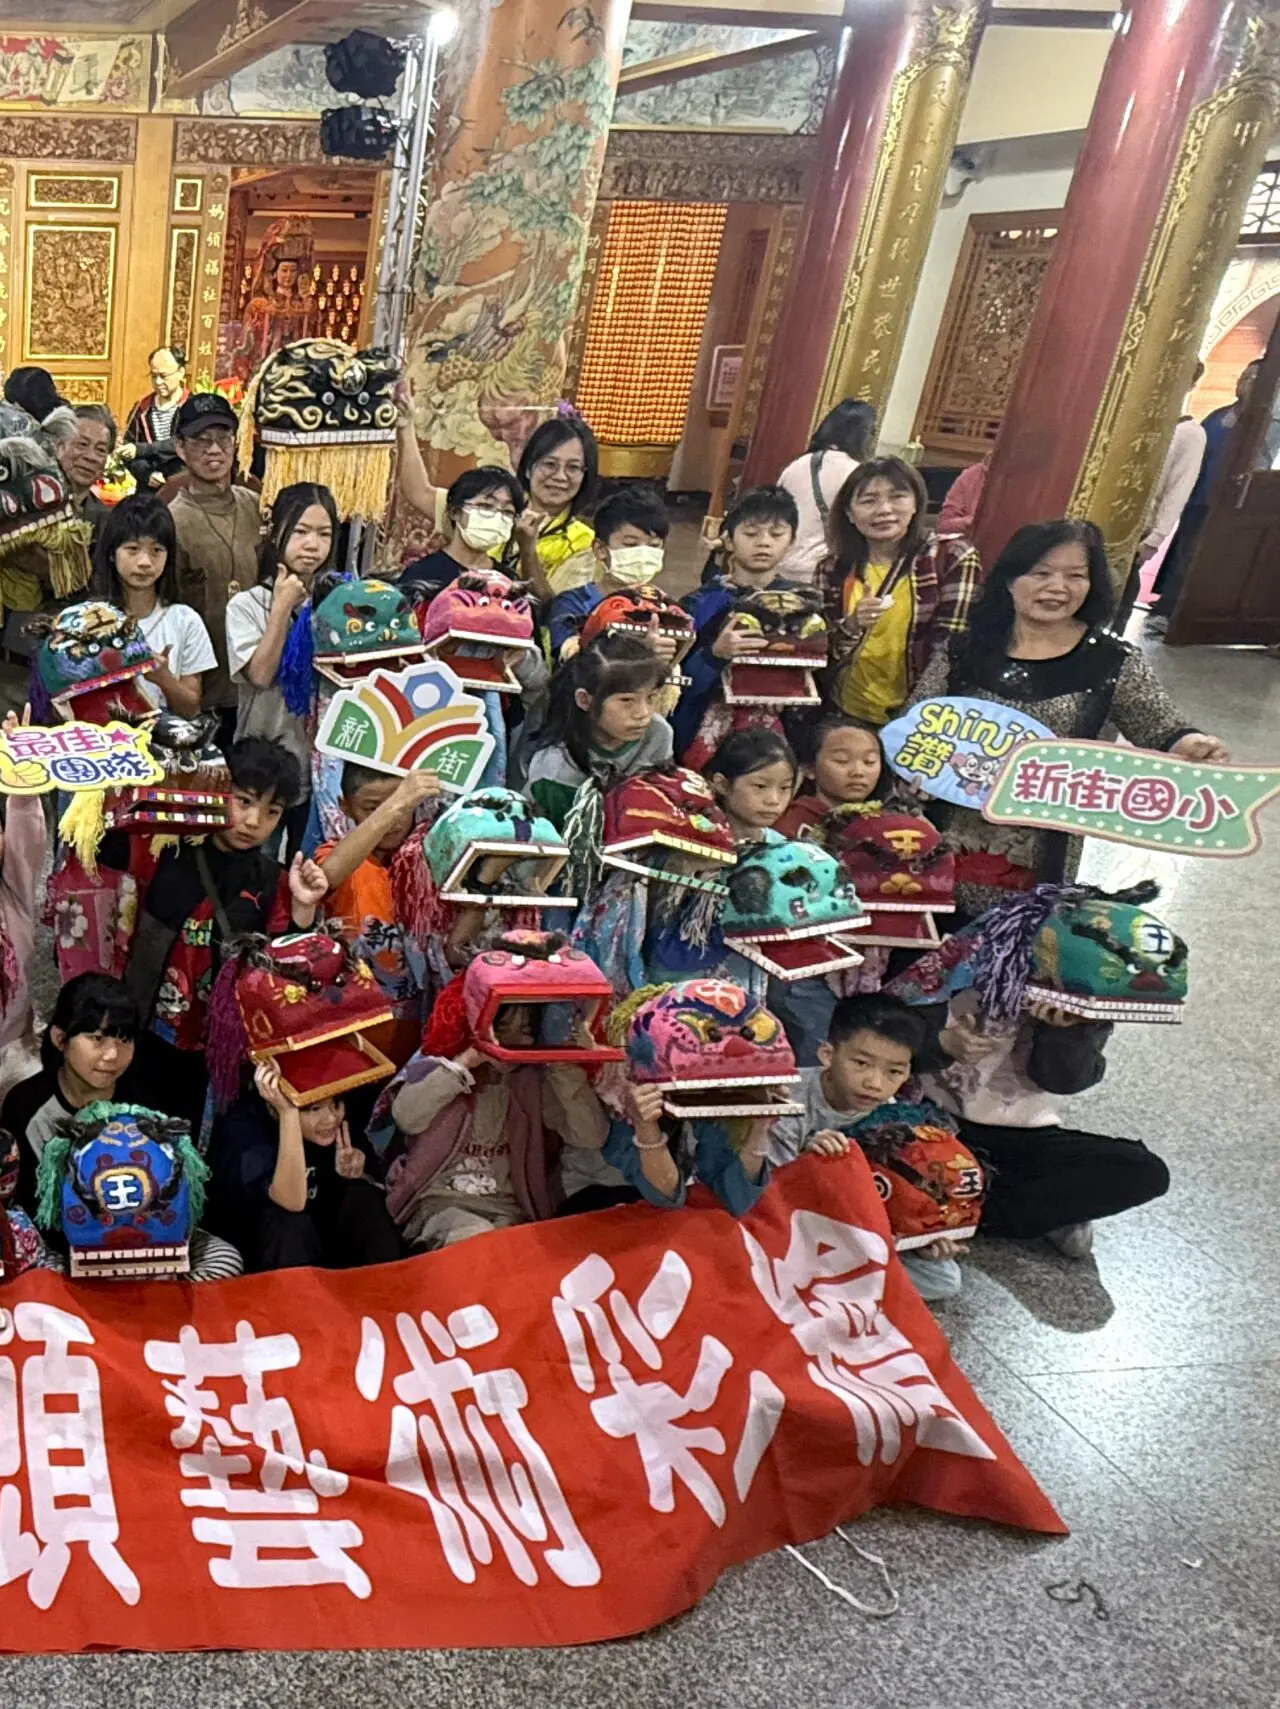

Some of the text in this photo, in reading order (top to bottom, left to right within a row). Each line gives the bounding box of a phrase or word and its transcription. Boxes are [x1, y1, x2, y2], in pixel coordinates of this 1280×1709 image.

[7, 727, 104, 759] 最佳
[335, 716, 470, 781] 新 街
[50, 750, 154, 784] 團隊
[1013, 757, 1240, 833] 新街國小
[1143, 922, 1172, 955] 王
[106, 1174, 140, 1209] 王
[953, 1170, 982, 1196] 王
